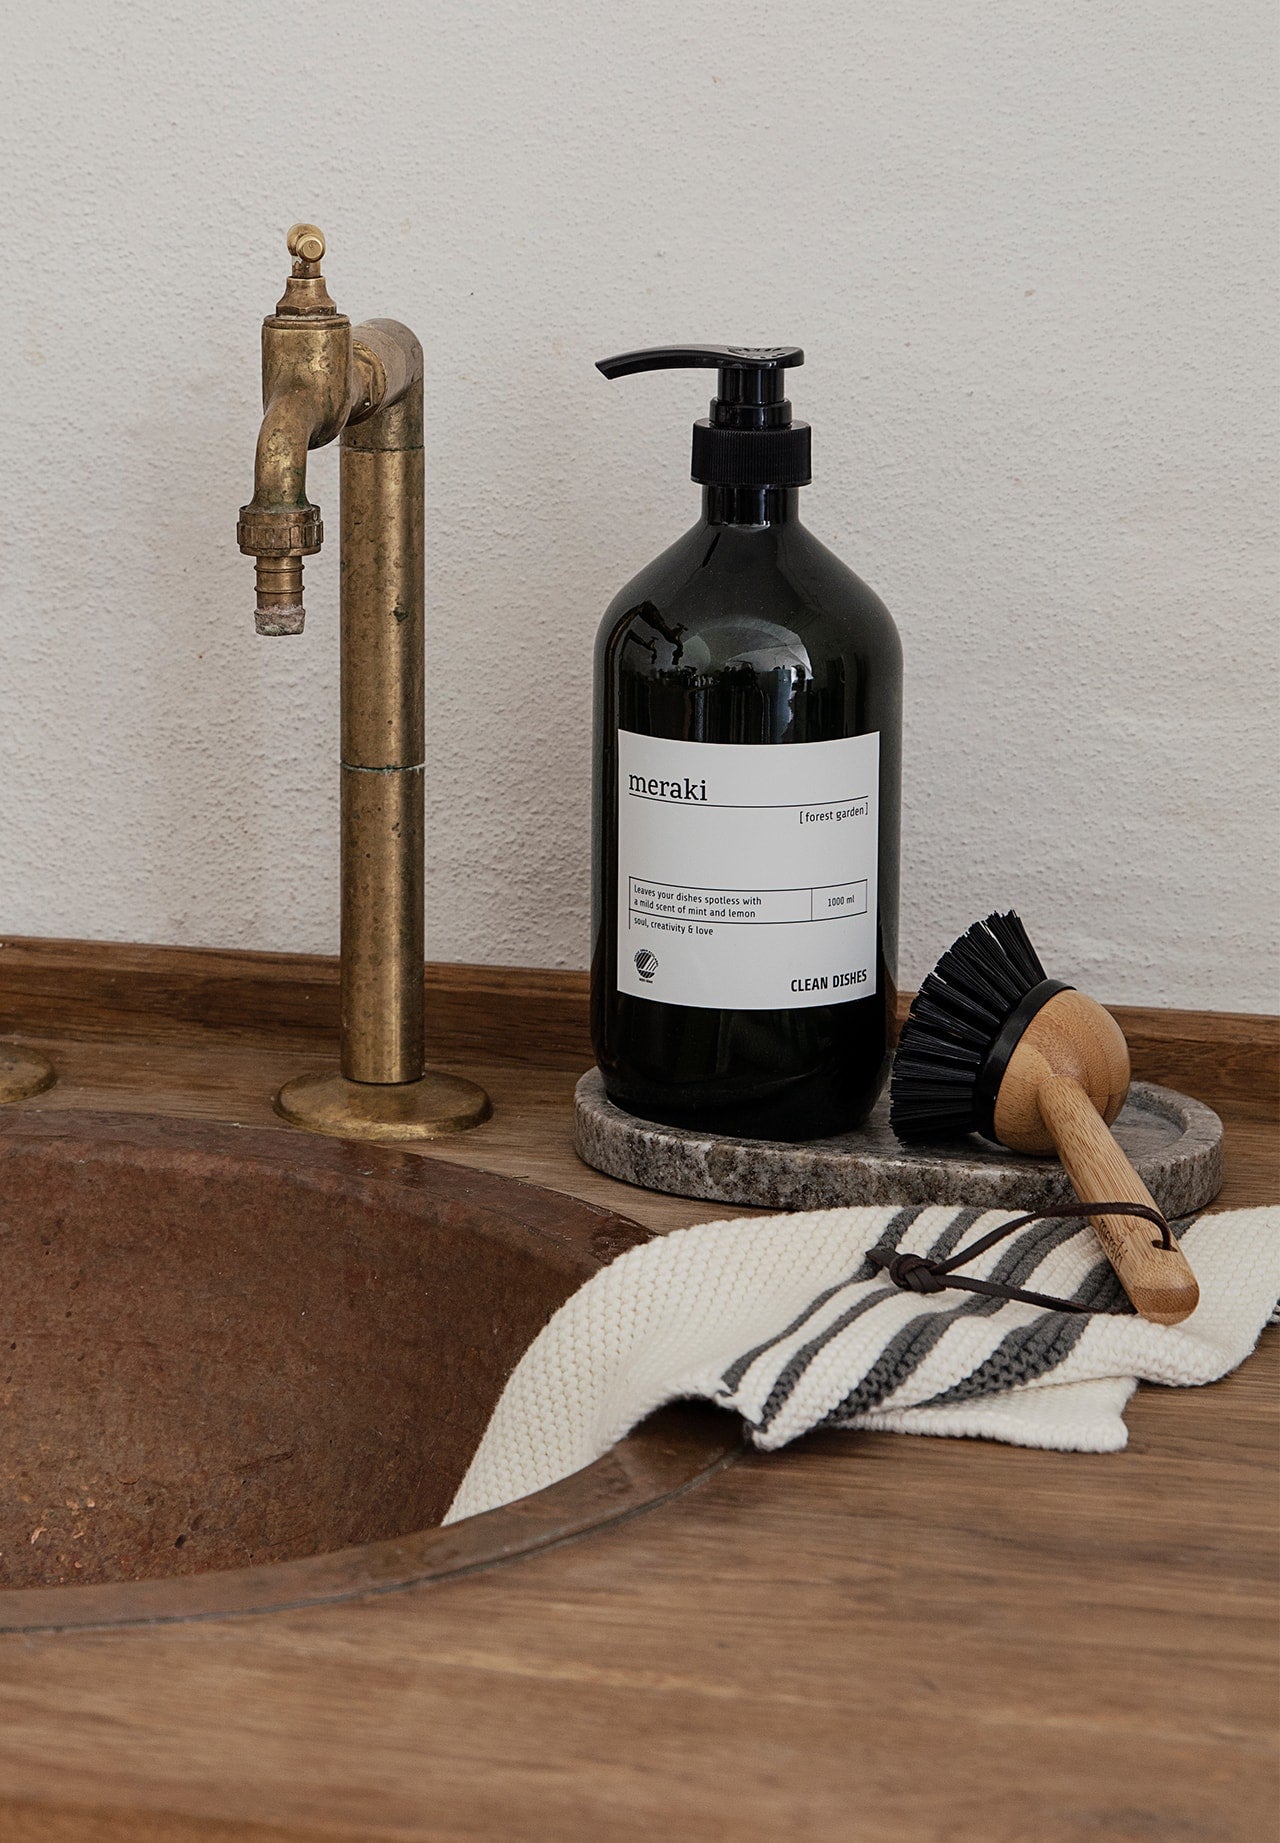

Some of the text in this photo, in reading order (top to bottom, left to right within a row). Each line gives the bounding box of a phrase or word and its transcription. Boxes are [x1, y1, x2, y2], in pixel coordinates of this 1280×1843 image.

[628, 773, 708, 801] meraki
[634, 884, 762, 906] Leaves your dishes spotless with
[827, 894, 855, 907] 1000 ml
[639, 899, 654, 909] mild
[655, 903, 675, 913] scent
[677, 905, 686, 914] of
[688, 907, 707, 916] mint
[709, 908, 726, 917] and
[728, 909, 756, 918] lemon
[634, 917, 714, 936] soul, creativity & love
[790, 968, 867, 993] CLEAN DISHES
